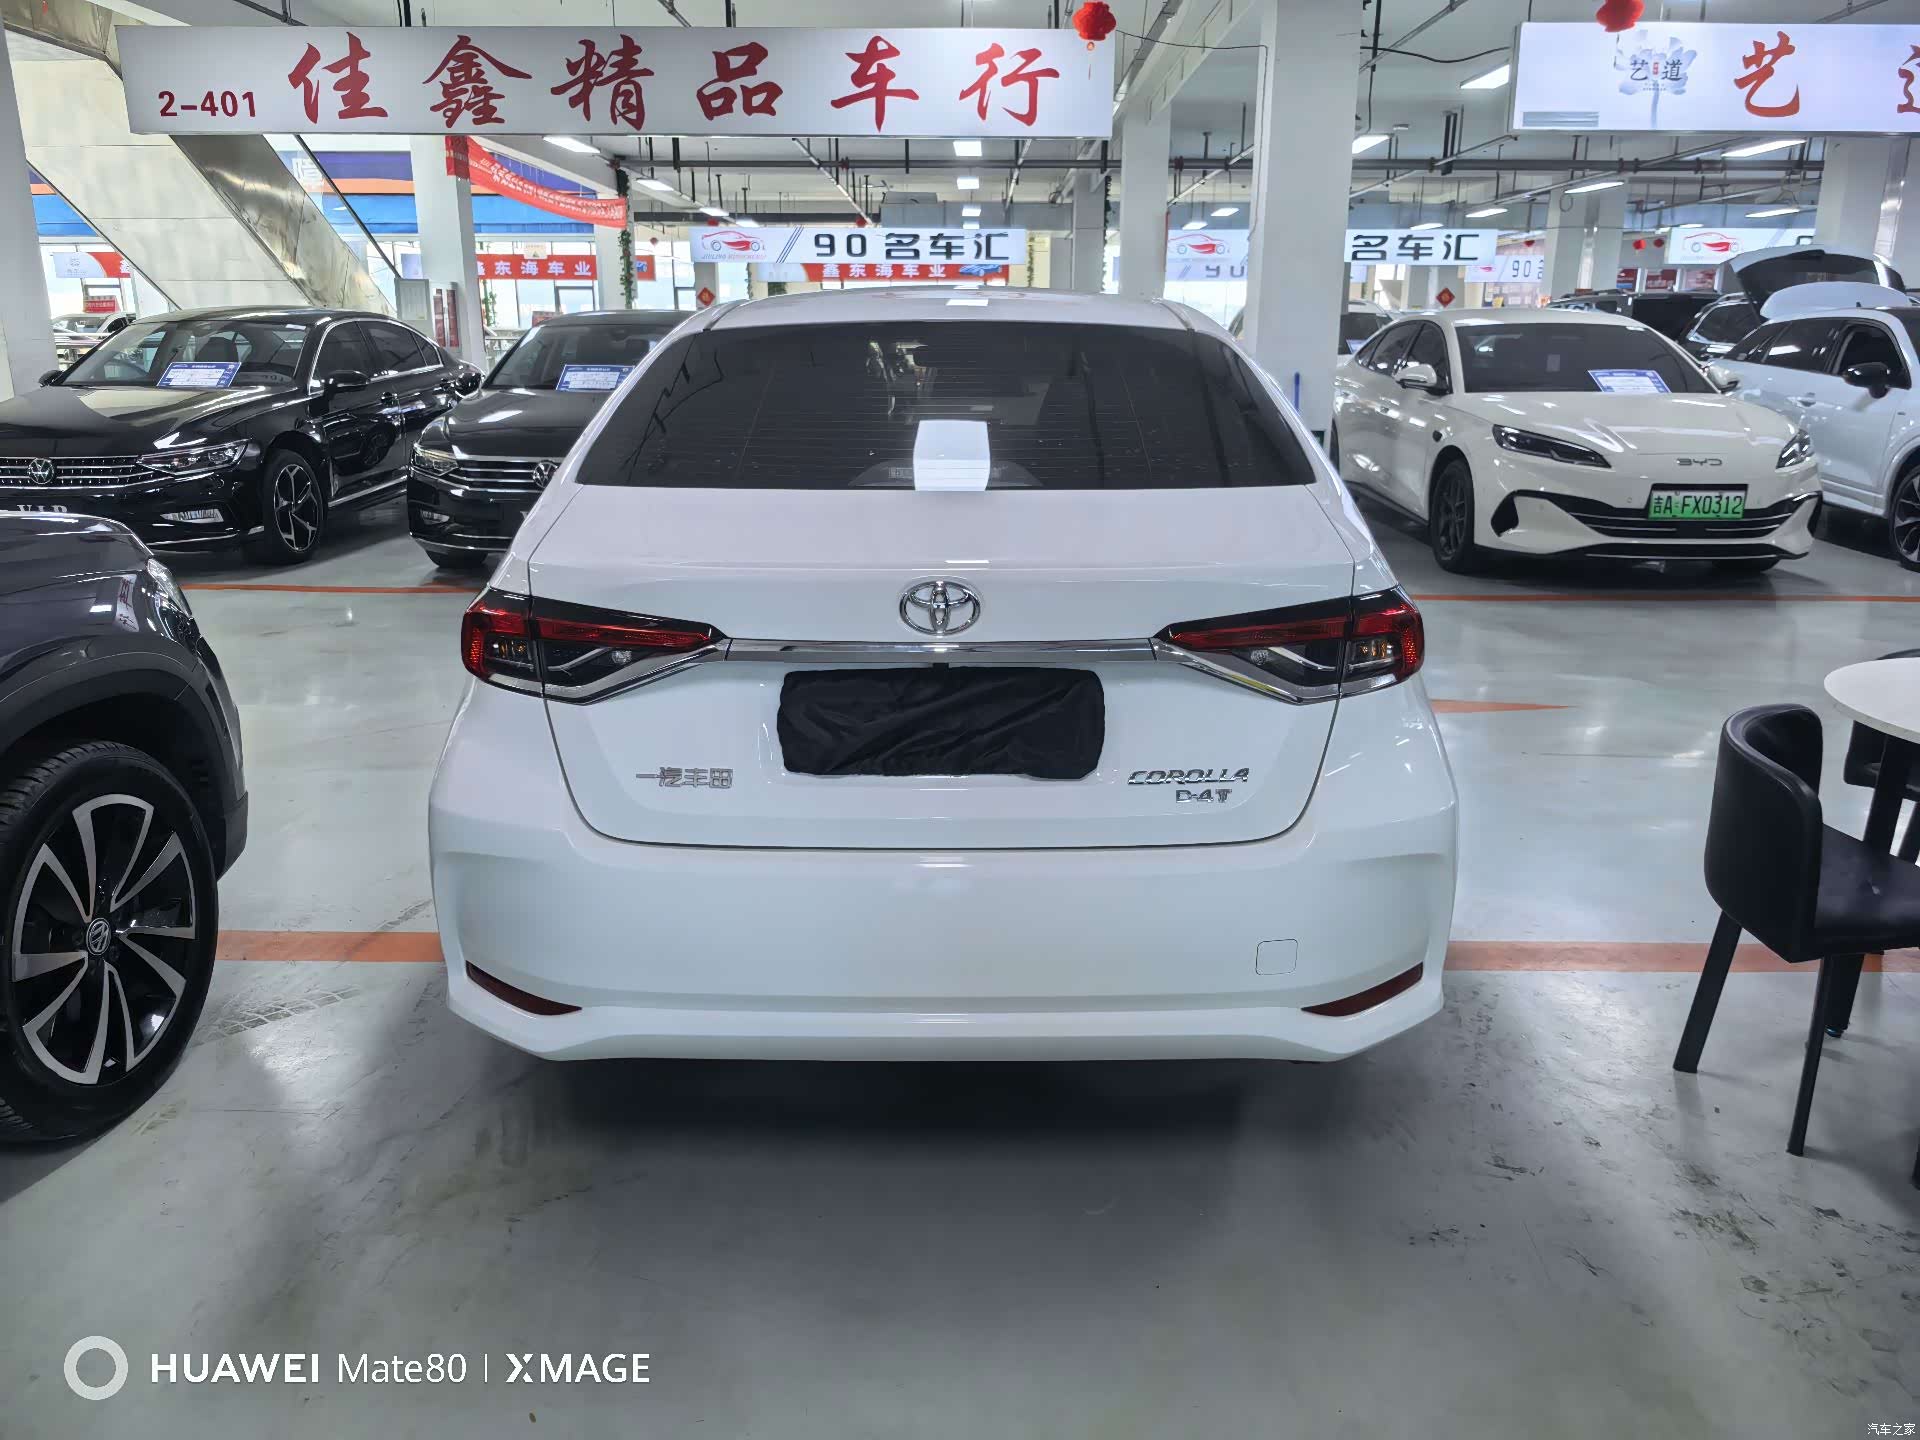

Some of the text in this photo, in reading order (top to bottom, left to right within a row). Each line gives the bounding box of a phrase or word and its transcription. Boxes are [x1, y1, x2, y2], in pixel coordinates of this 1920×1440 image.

[288, 32, 1060, 132] 佳鑫精品车行
[1630, 59, 1683, 82] 艺道
[158, 90, 256, 118] 2-401
[1351, 233, 1480, 261] 名车汇
[1677, 457, 1723, 466] BYD
[635, 766, 734, 789] 一汽丰田
[1127, 767, 1250, 785] COROLLA
